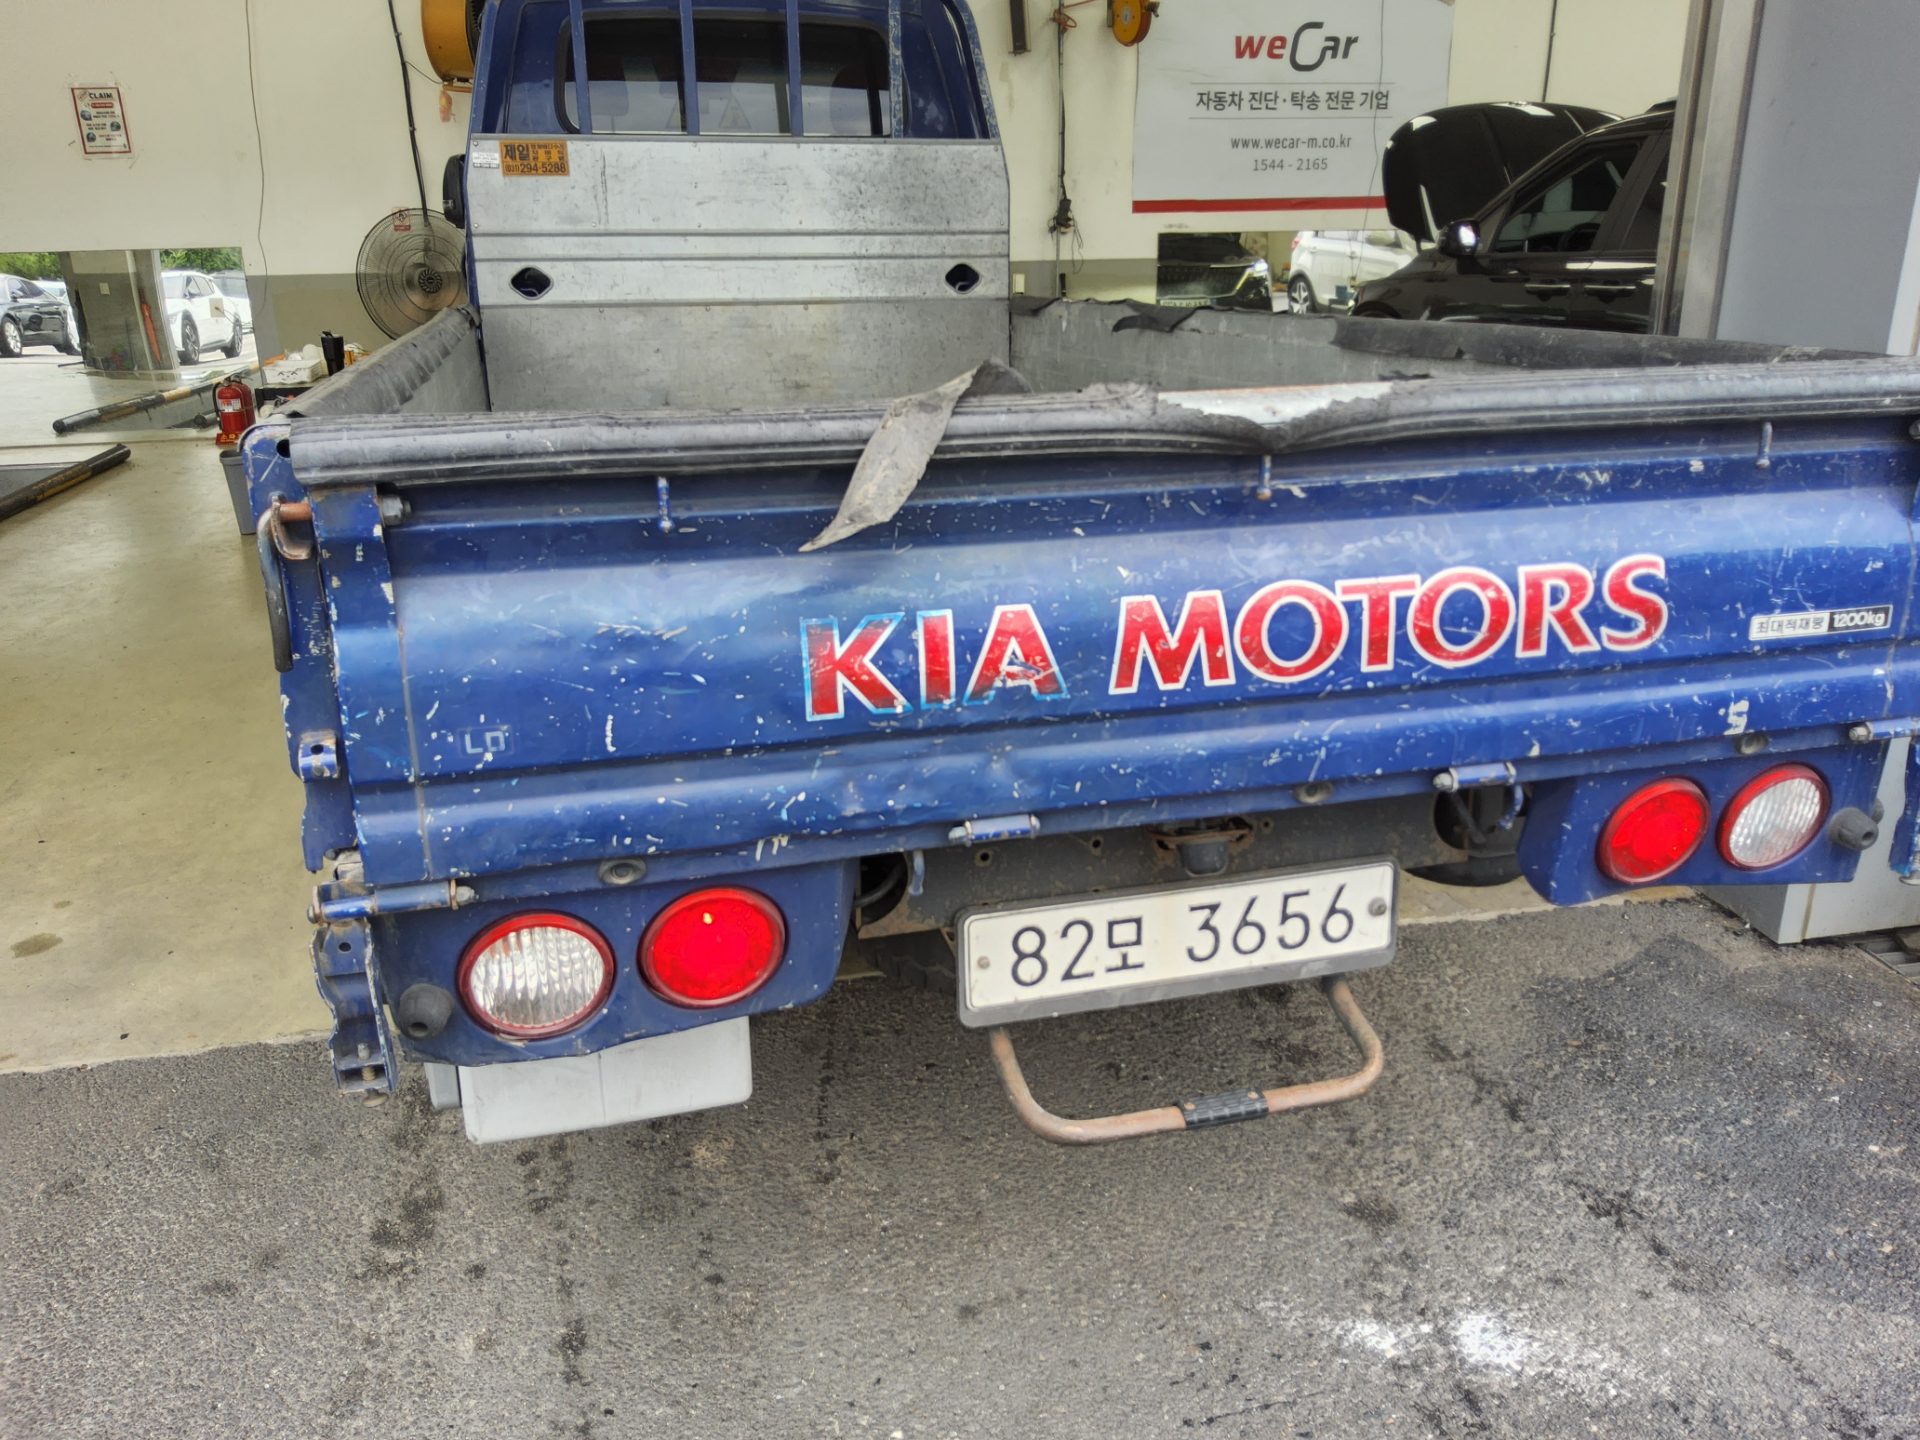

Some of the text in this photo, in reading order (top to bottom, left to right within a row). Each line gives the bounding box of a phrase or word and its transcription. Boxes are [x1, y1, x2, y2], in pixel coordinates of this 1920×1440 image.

[1195, 90, 1245, 112] 자동차
[1325, 90, 1356, 111] 전문
[1360, 89, 1390, 111] 기업
[1230, 133, 1352, 150] www.wecar-m.co.kr
[504, 143, 529, 160] 제일
[1252, 158, 1285, 171] 1544
[1296, 158, 1328, 171] 2165
[1832, 611, 1885, 628] 1200kg
[799, 553, 1669, 722] KIA MOTORS
[1010, 884, 1355, 987] 82모 3656
